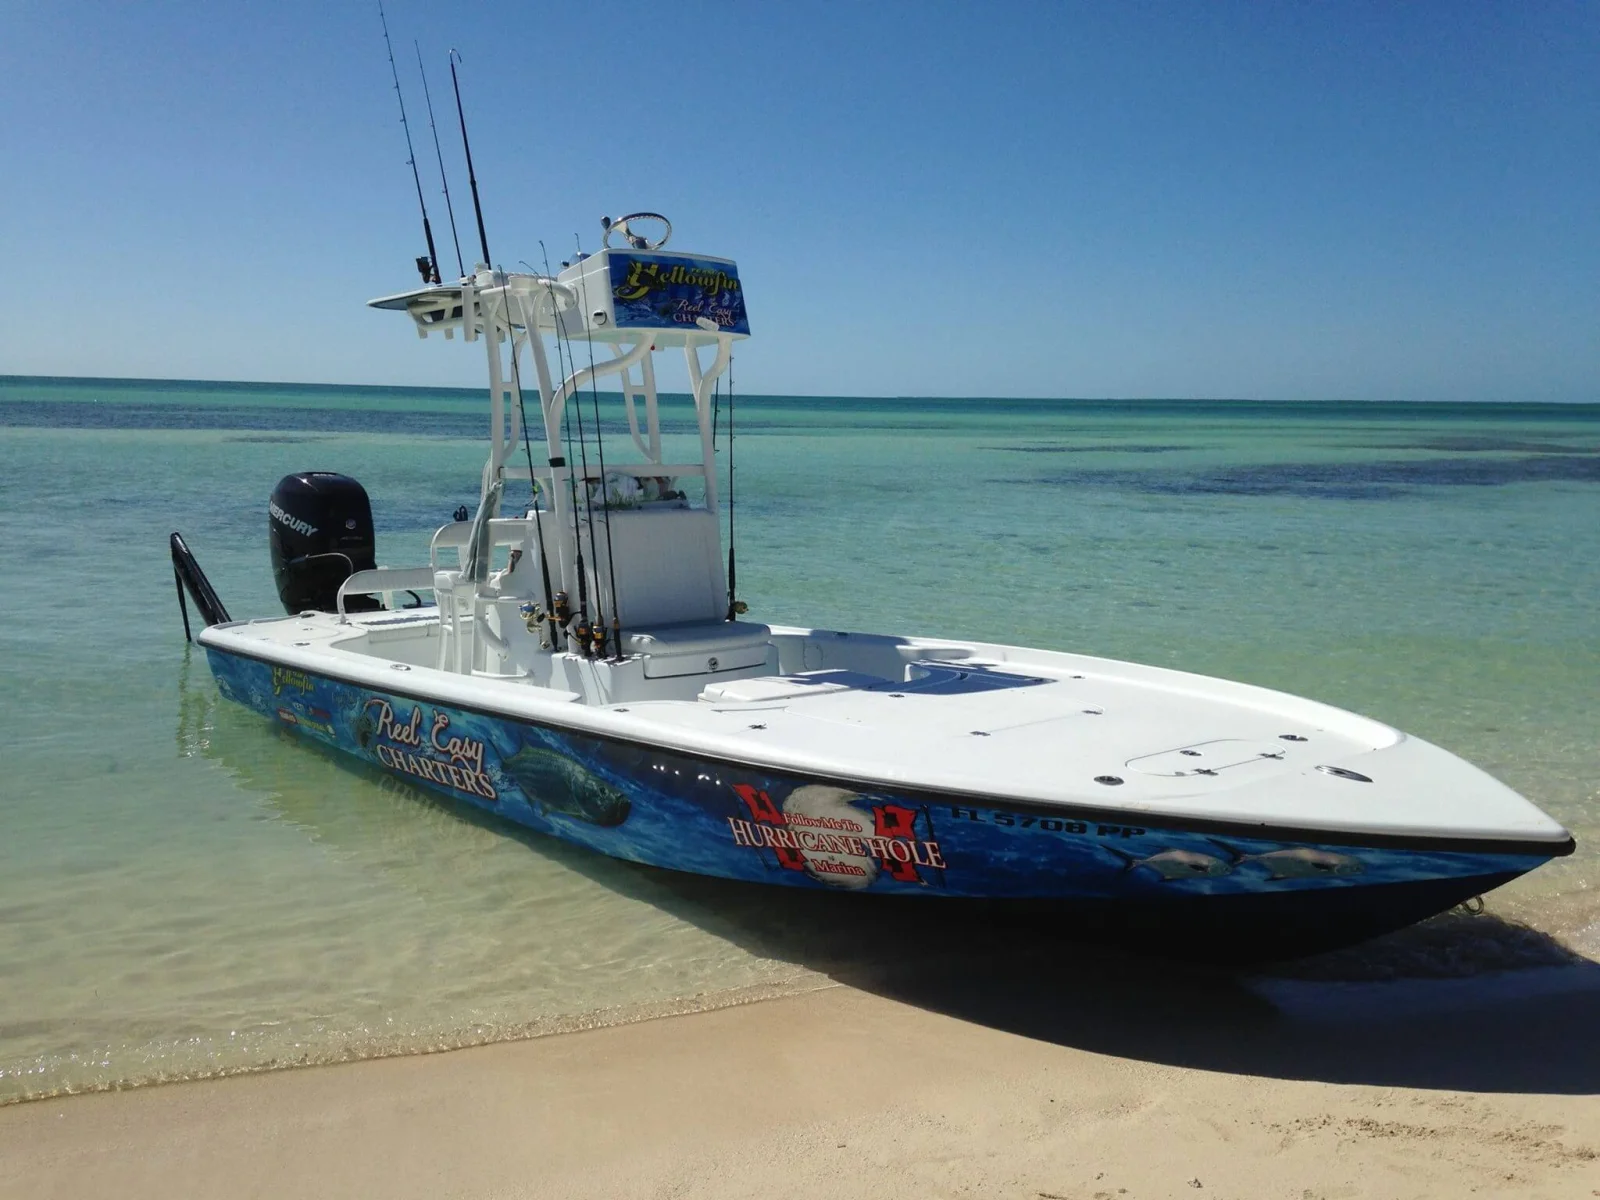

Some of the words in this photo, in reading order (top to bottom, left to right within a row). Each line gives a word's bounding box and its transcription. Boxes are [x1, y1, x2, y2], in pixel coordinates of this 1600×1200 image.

[617, 261, 737, 299] Yellowfin
[673, 313, 734, 327] CHERS
[675, 299, 704, 313] Reel
[708, 298, 732, 318] Easy
[269, 500, 319, 537] MERCURY
[365, 699, 422, 746] Reel
[431, 709, 485, 776] Easy
[376, 744, 498, 800] CHARTERS
[783, 811, 821, 828] Follow
[820, 817, 843, 831] Me
[842, 819, 863, 833] To
[951, 806, 987, 823] FL
[1097, 824, 1147, 839] PP
[727, 816, 866, 857] HURRICANE
[866, 835, 947, 870] HOLE
[811, 858, 866, 876] Marina
